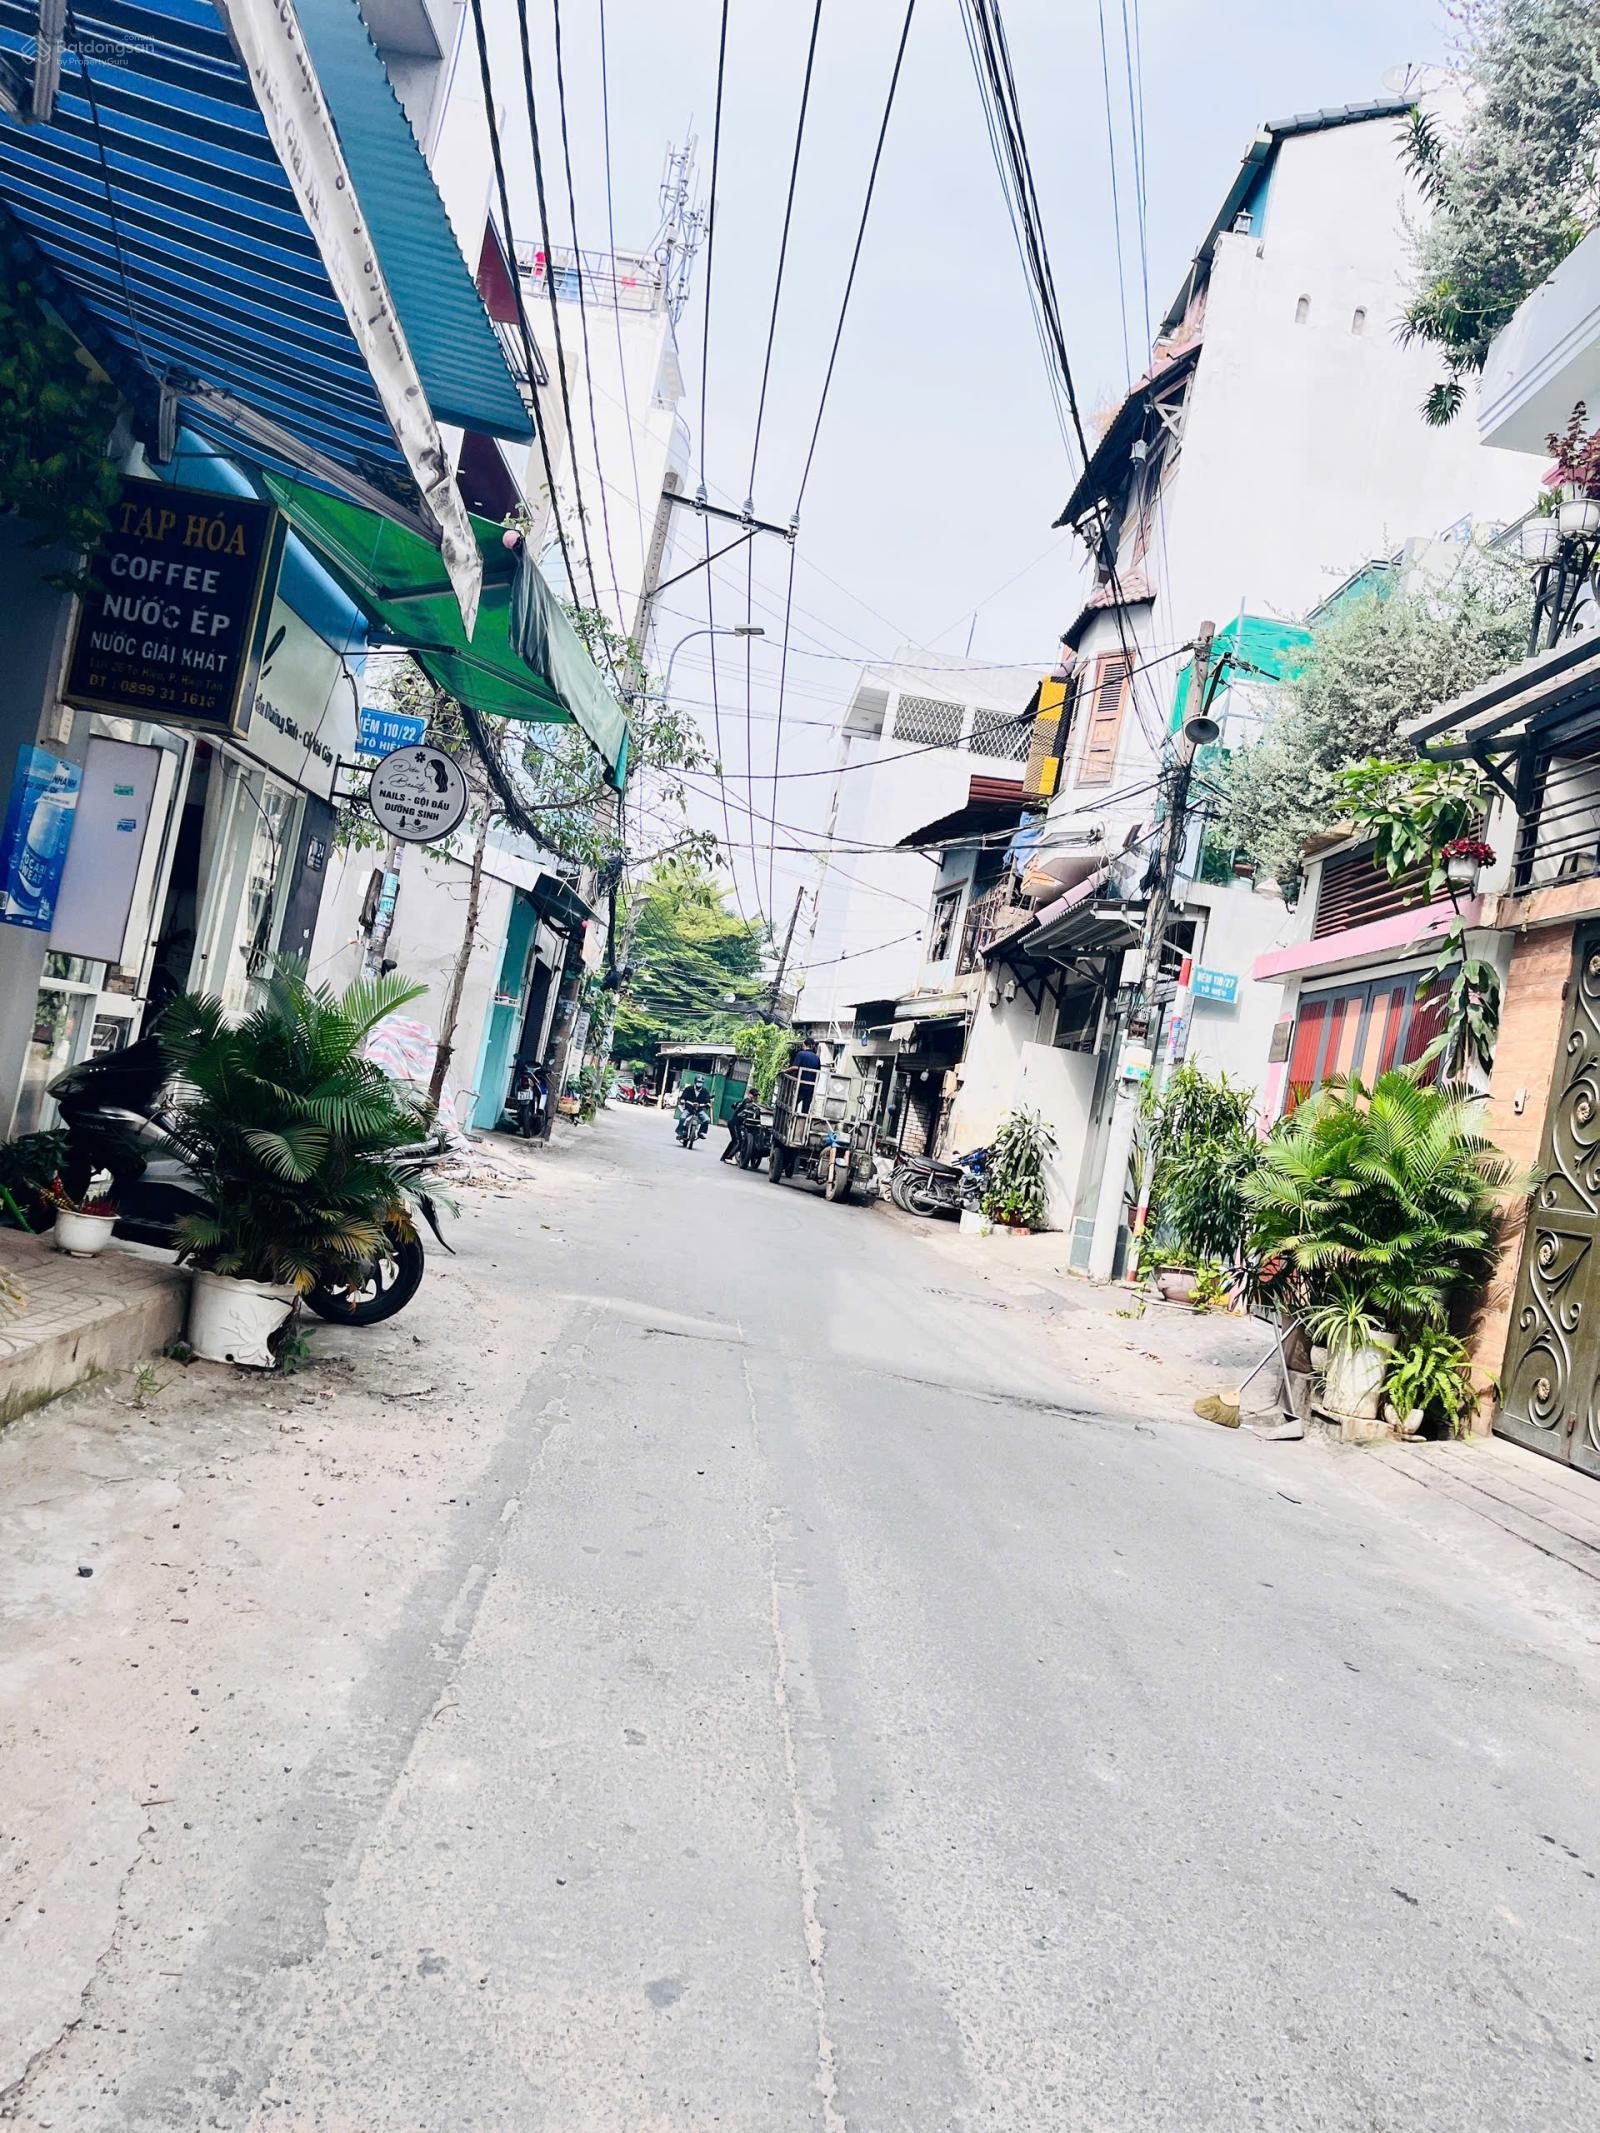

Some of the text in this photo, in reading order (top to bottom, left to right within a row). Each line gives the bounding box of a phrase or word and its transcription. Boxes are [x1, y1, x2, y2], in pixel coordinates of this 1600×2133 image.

[120, 502, 246, 556] TẠP HÓA
[110, 553, 220, 593] COFFEE
[103, 594, 230, 637] NƯỚC ÉP
[141, 637, 176, 664] GIẢI
[180, 648, 228, 673] KHÁT
[360, 713, 417, 742] ẺM 110/22
[363, 737, 377, 748] TÔ
[379, 789, 406, 801] NAILS
[413, 796, 430, 807] GỘI
[416, 810, 440, 821] SINH
